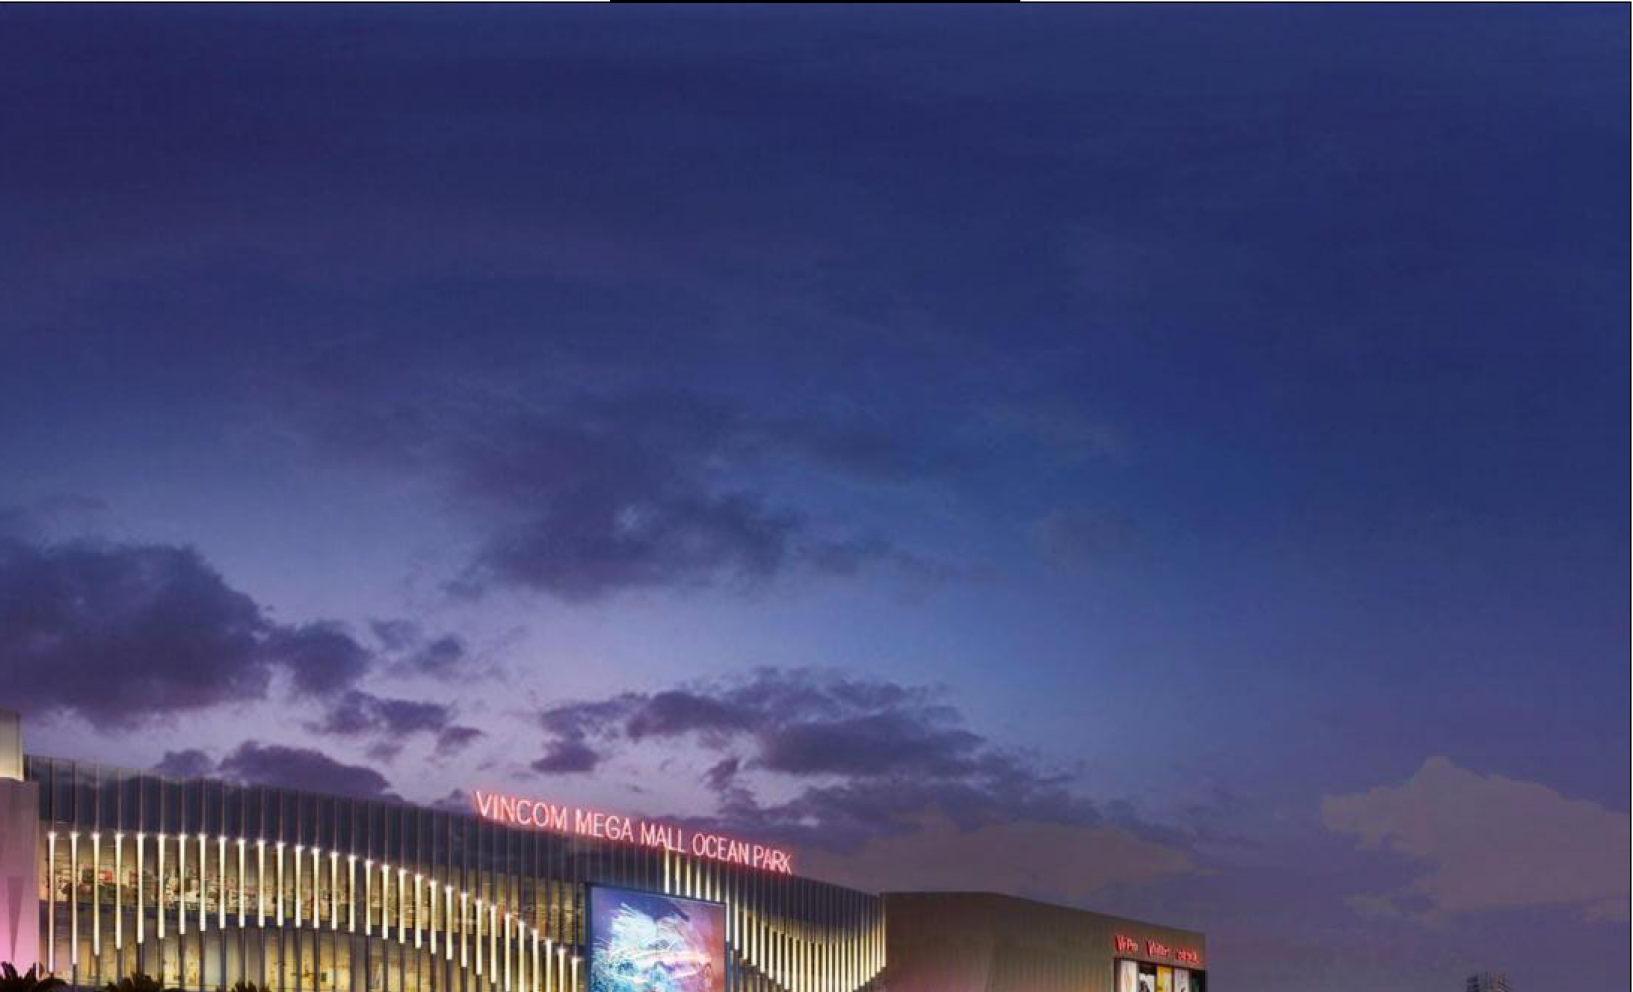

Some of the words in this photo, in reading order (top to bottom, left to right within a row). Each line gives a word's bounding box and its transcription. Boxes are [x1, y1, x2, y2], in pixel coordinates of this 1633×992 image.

[475, 791, 568, 833] VINCOM
[574, 807, 635, 843] MEGA
[640, 821, 687, 853] MALL
[692, 832, 750, 866] OCEAN
[753, 844, 794, 875] PARK
